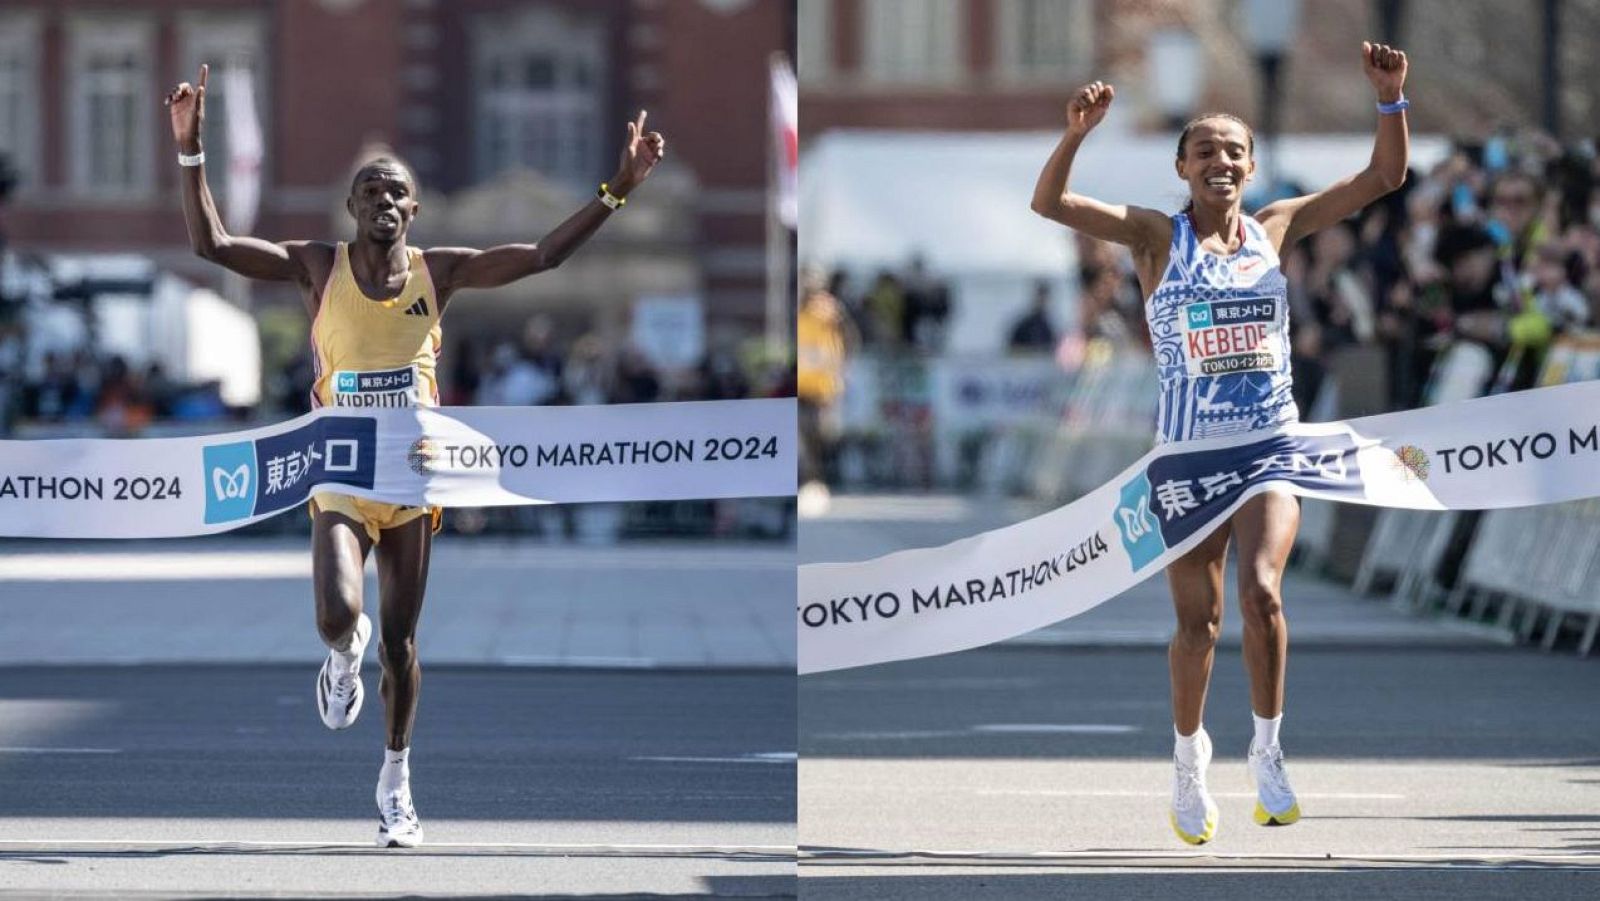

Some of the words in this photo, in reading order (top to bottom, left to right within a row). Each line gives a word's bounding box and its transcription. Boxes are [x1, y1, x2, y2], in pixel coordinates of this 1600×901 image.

[1216, 305, 1272, 319] 東京メトロ
[1187, 324, 1269, 359] KEBEDE
[361, 372, 410, 388] 東京メトロ
[265, 440, 359, 495] 東京メトロ
[445, 444, 528, 468] TOKYO
[536, 439, 695, 467] MARATHON
[703, 436, 778, 462] 2024
[1436, 432, 1557, 473] TOKYO
[113, 476, 182, 500] 2024
[797, 591, 900, 628] OKYO
